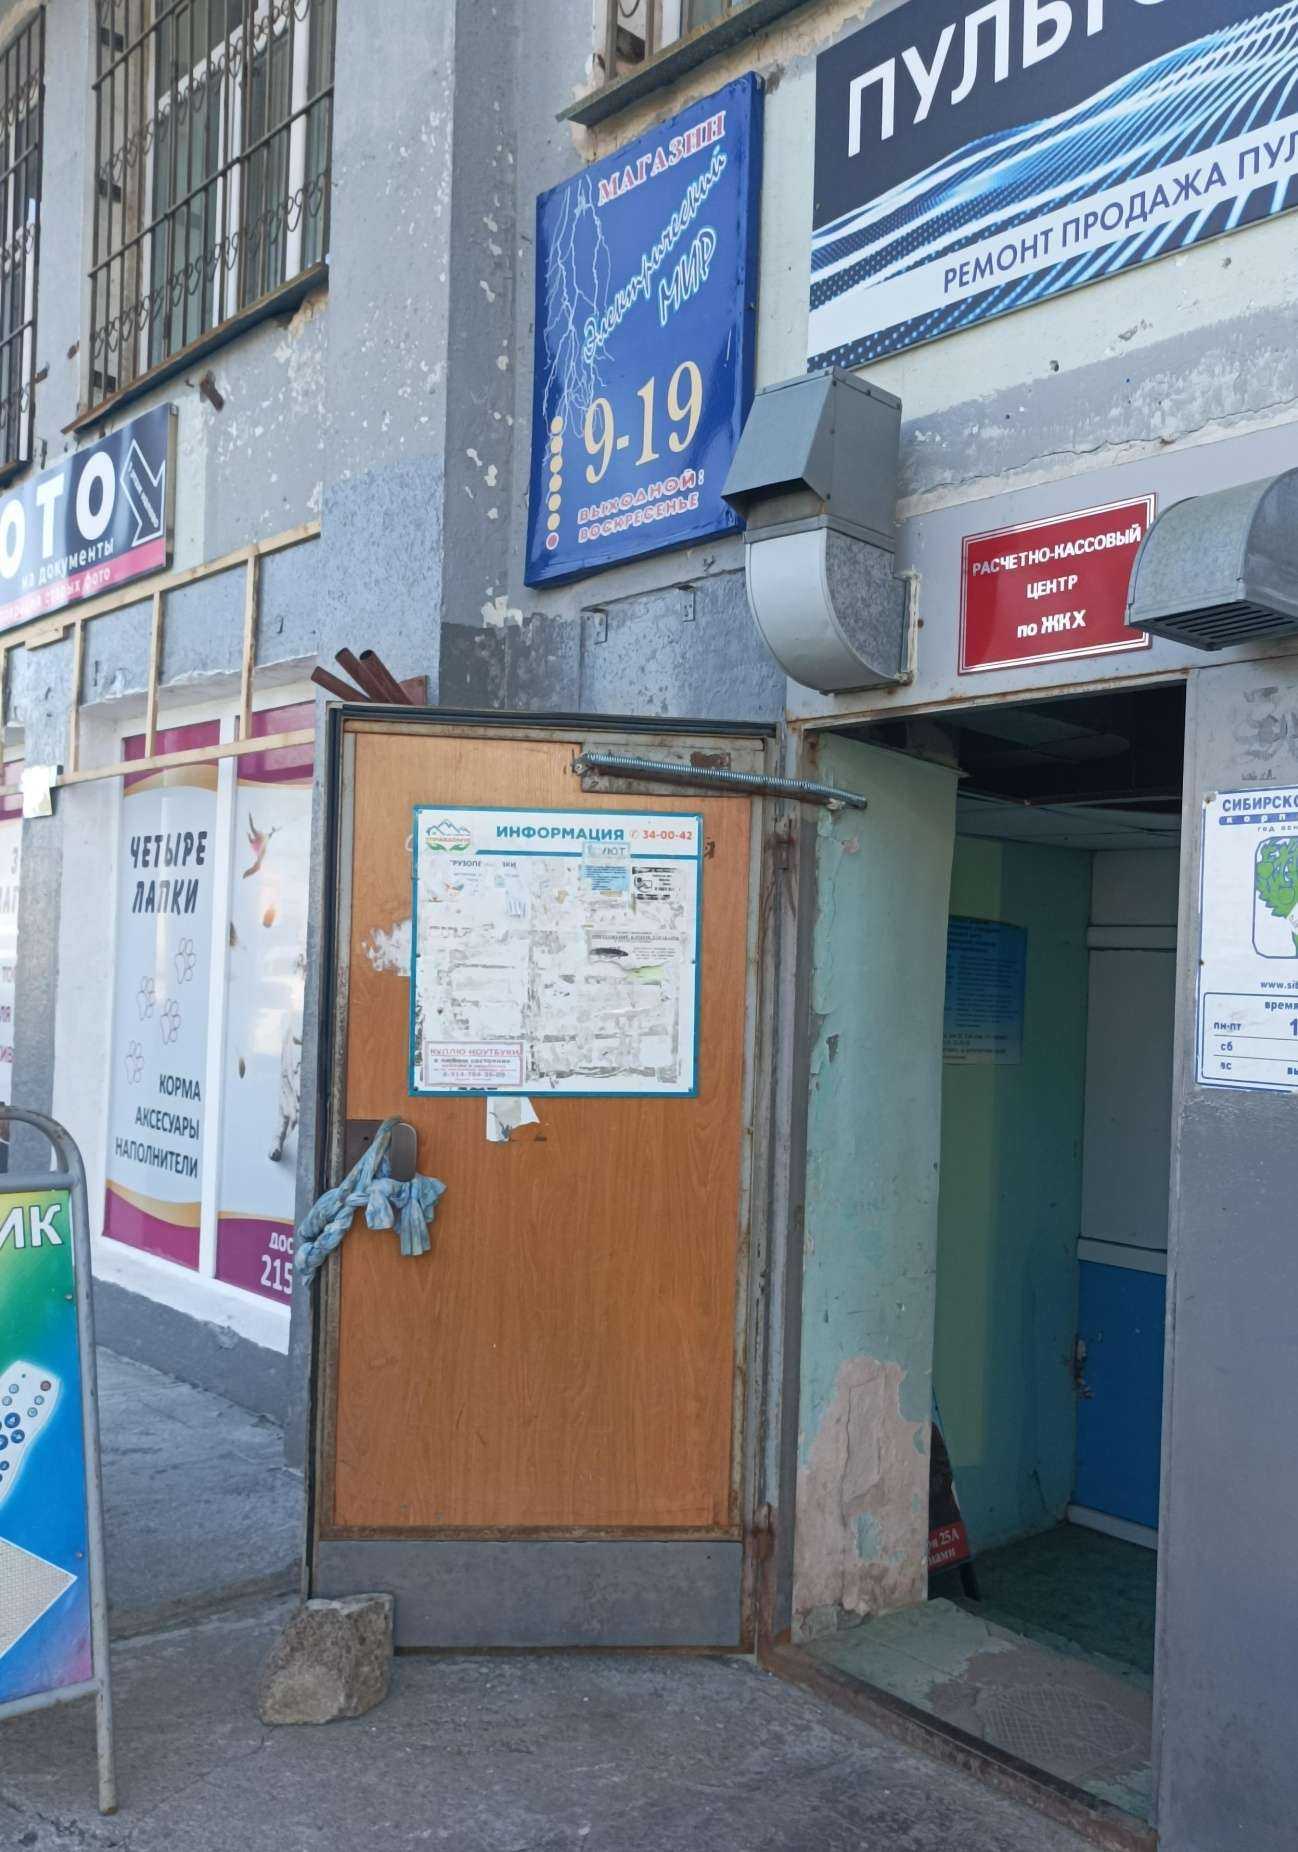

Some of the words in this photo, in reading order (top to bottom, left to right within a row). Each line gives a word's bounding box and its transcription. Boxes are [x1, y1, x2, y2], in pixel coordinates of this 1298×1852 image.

[848, 0, 1165, 157] ПУЛЬ
[598, 110, 727, 207] МАГАЗИН
[943, 227, 1054, 294] РЕМОНТ
[1061, 161, 1227, 248] ПРОДАЖА
[583, 144, 728, 364] Электрический
[658, 227, 717, 328] МИР
[583, 360, 703, 484] 9-19
[578, 492, 699, 543] ВОСКРЕСЕНЬЕ
[38, 538, 114, 585] документы
[972, 524, 1141, 576] РАСЧЕТНО-КАССОВЫЙ
[1026, 575, 1078, 599] ЦЕНТР
[1017, 623, 1037, 638] по
[131, 831, 207, 869] ЧЕТЫРЕ
[496, 826, 625, 841] ИНФОРМАЦИЯ
[642, 830, 692, 840] 34-00-42
[132, 879, 199, 915] ЛАПКИ
[1220, 1041, 1233, 1051] сб
[159, 1074, 201, 1101] КОРМА
[135, 1106, 199, 1140] АКСЕСУАРЫ
[115, 1137, 198, 1179] НАПОЛНИТЕЛИ
[260, 1254, 293, 1295] 215
